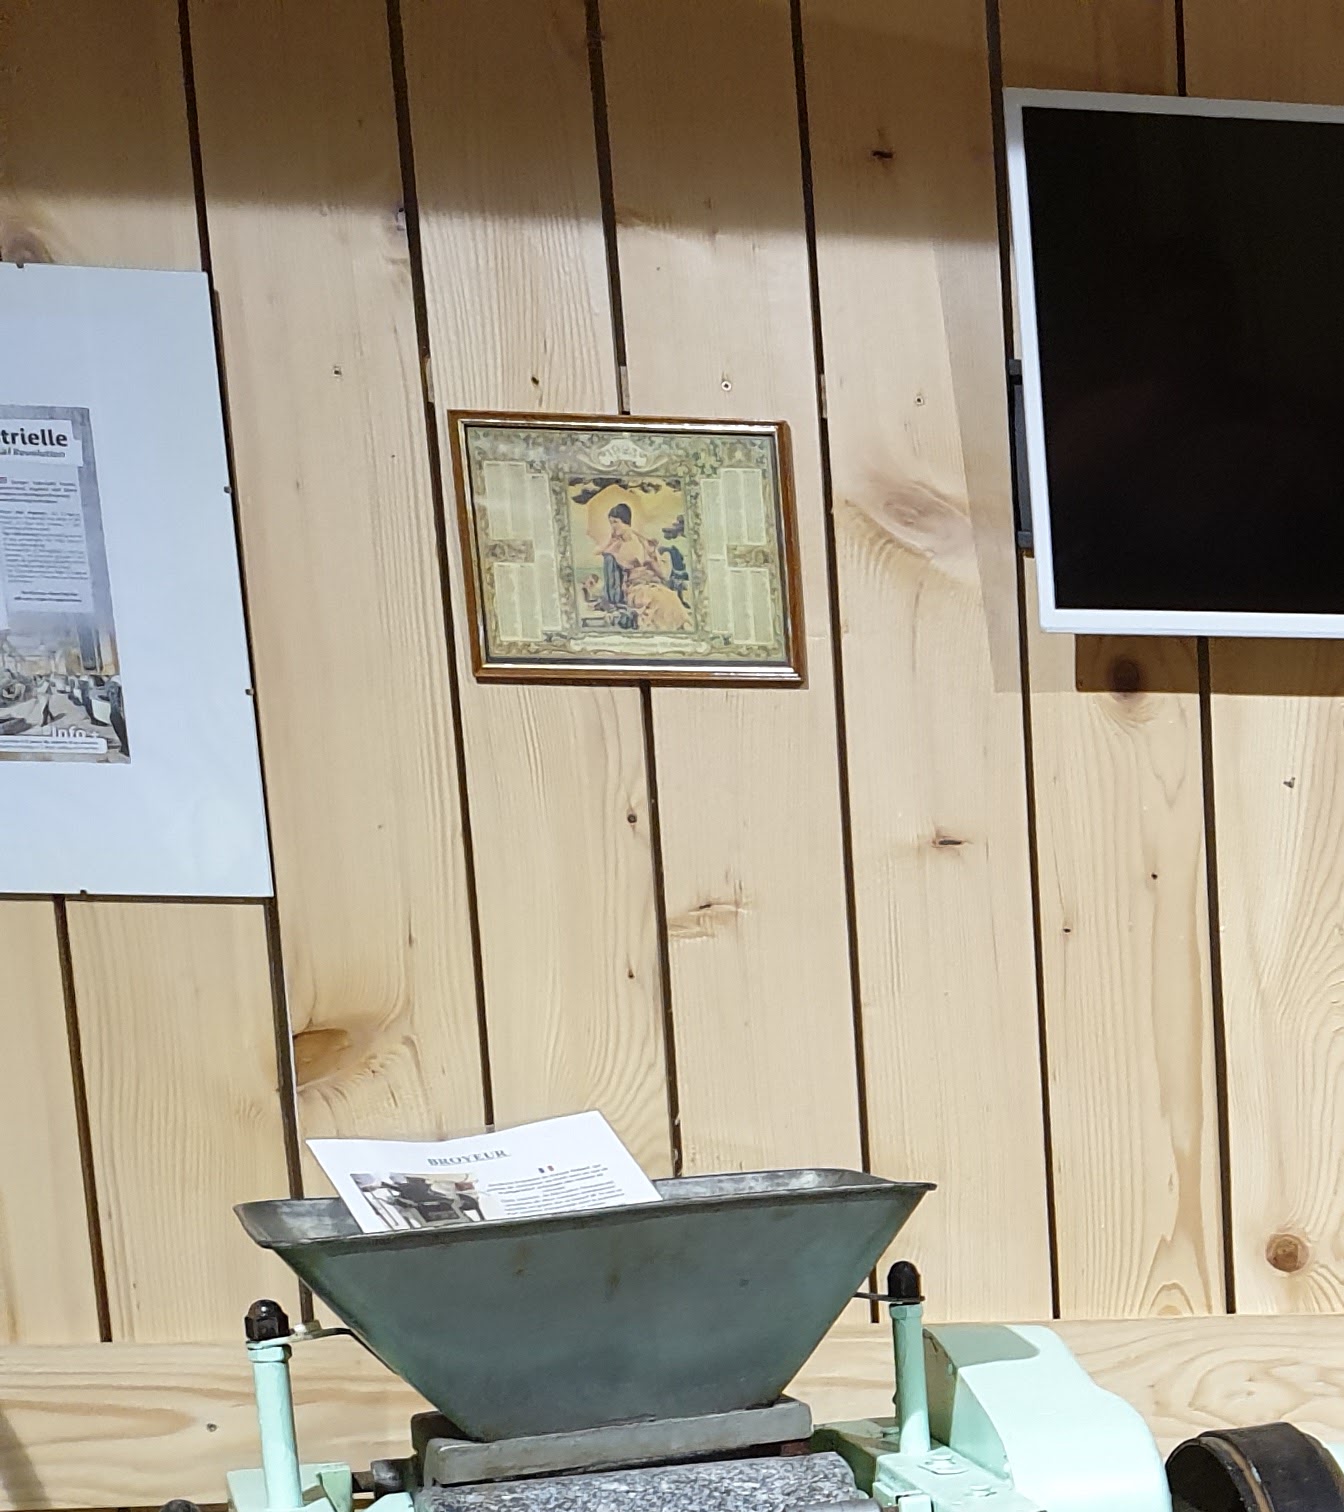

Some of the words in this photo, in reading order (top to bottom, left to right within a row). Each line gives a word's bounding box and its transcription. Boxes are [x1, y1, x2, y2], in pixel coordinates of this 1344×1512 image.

[0, 427, 68, 447] trielle
[51, 726, 87, 739] Info
[427, 1149, 511, 1166] BROYEUR
